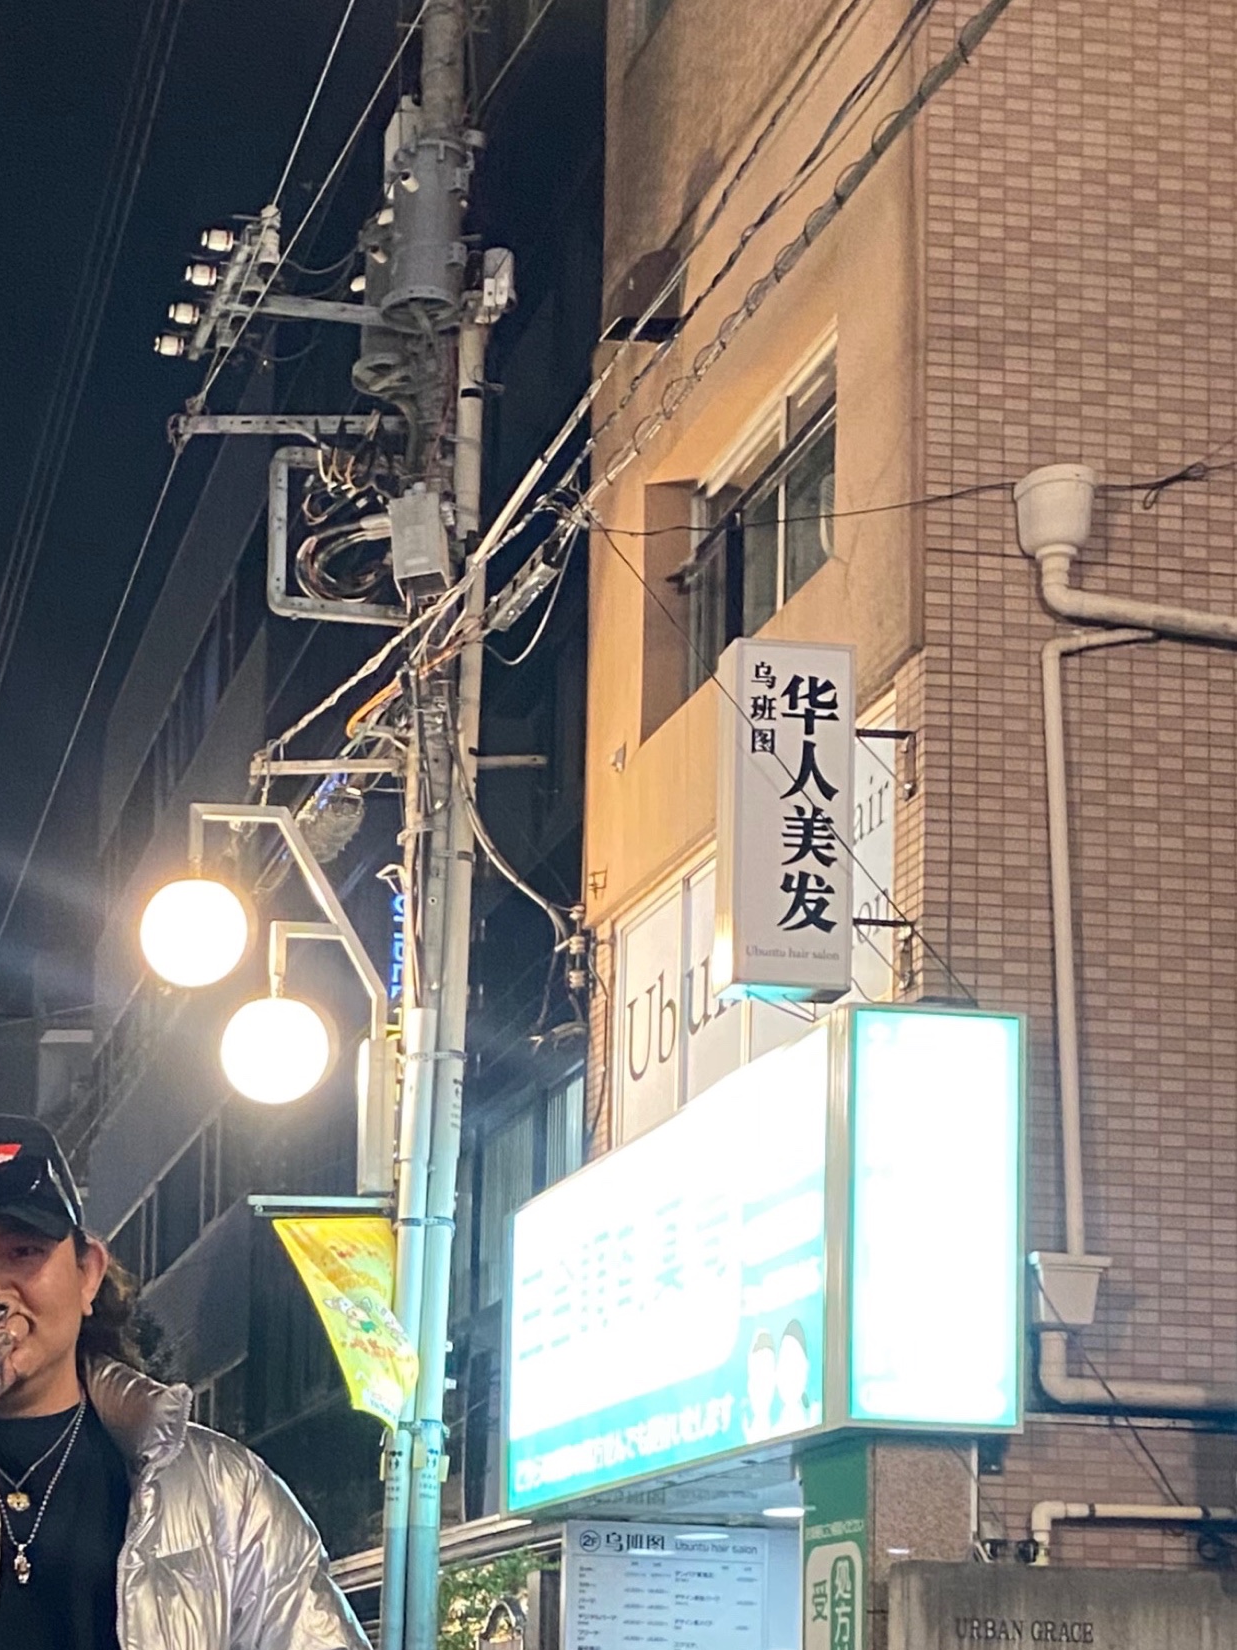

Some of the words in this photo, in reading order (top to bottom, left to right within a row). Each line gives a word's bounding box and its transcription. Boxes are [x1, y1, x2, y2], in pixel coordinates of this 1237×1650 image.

[751, 661, 777, 754] 乌班图
[777, 674, 840, 934] 华人美发
[746, 945, 786, 957] Ubuntu
[788, 947, 809, 958] hair
[812, 948, 840, 960] salon
[582, 1534, 598, 1547] 2F
[956, 1618, 1023, 1641] URBAN
[1031, 1620, 1094, 1643] GRACE
